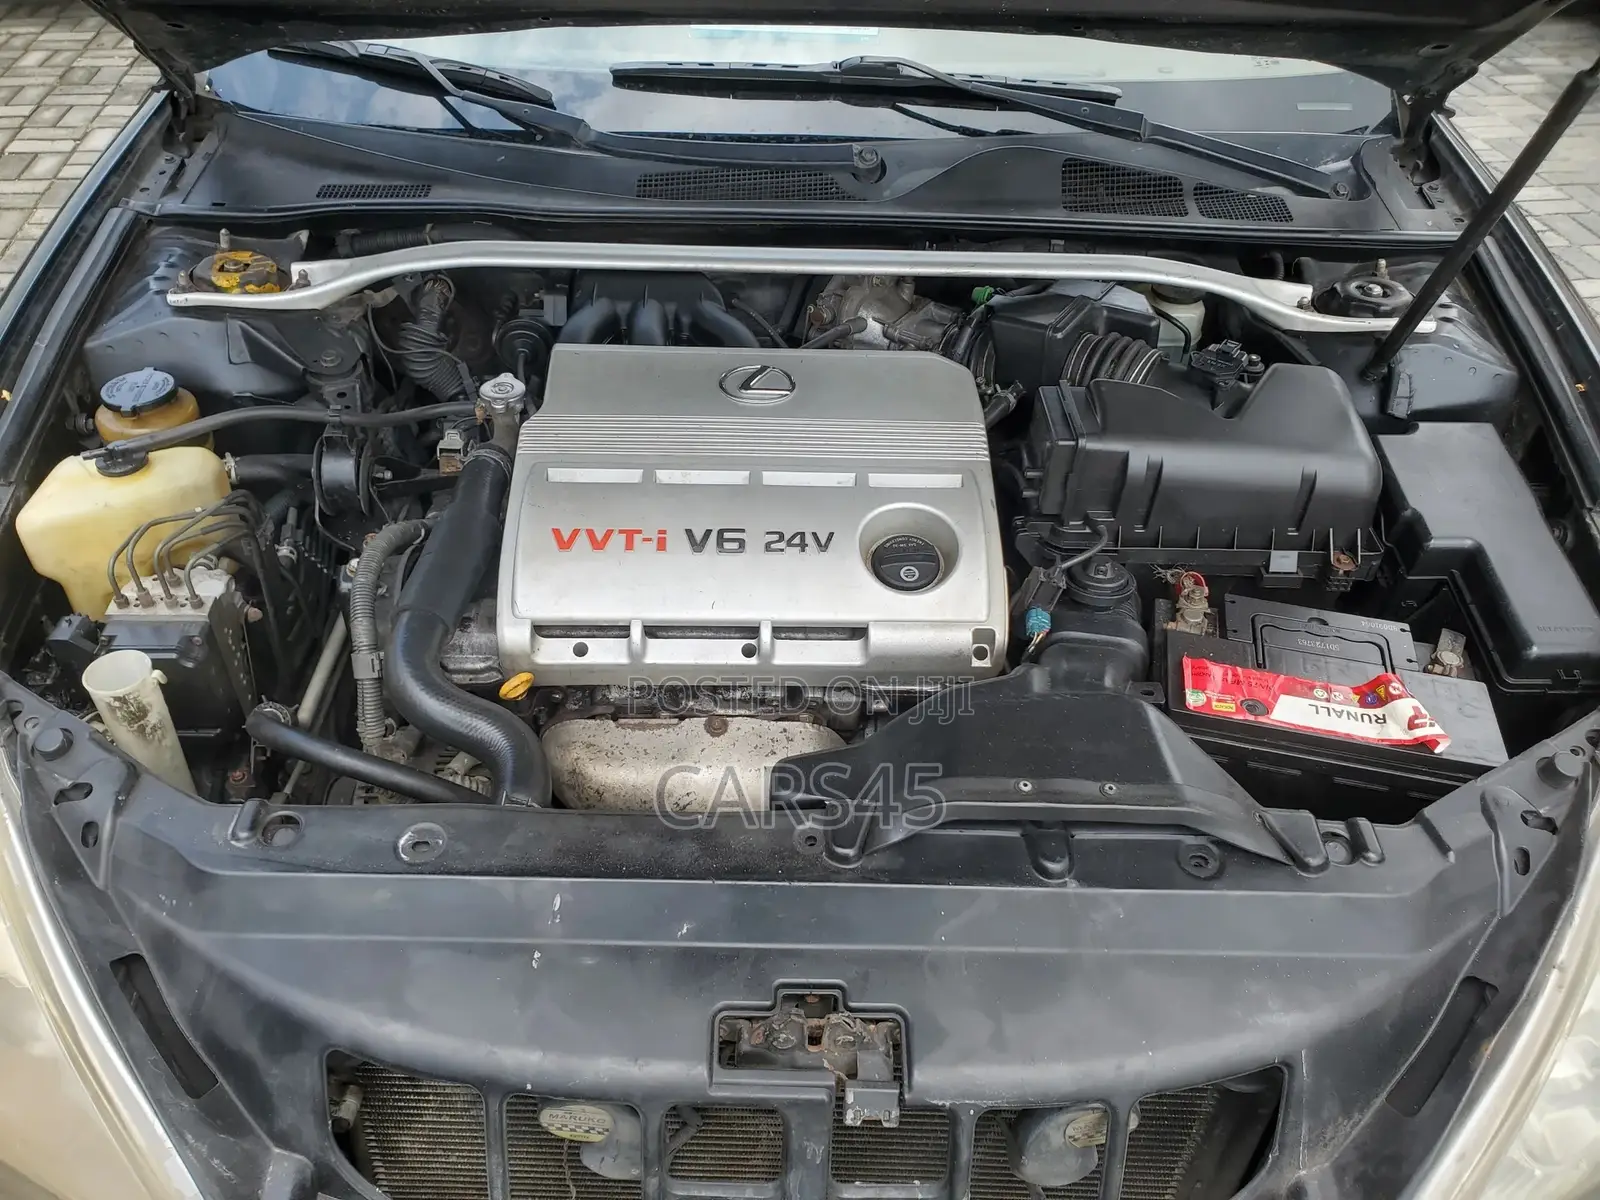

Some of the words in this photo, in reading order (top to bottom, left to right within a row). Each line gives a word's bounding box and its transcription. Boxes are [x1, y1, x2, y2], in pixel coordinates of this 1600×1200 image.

[551, 527, 668, 552] VVT-i
[684, 528, 747, 555] V6
[763, 531, 835, 554] 24V
[1308, 703, 1387, 725] RUNALL
[548, 1113, 606, 1124] MARUKO
